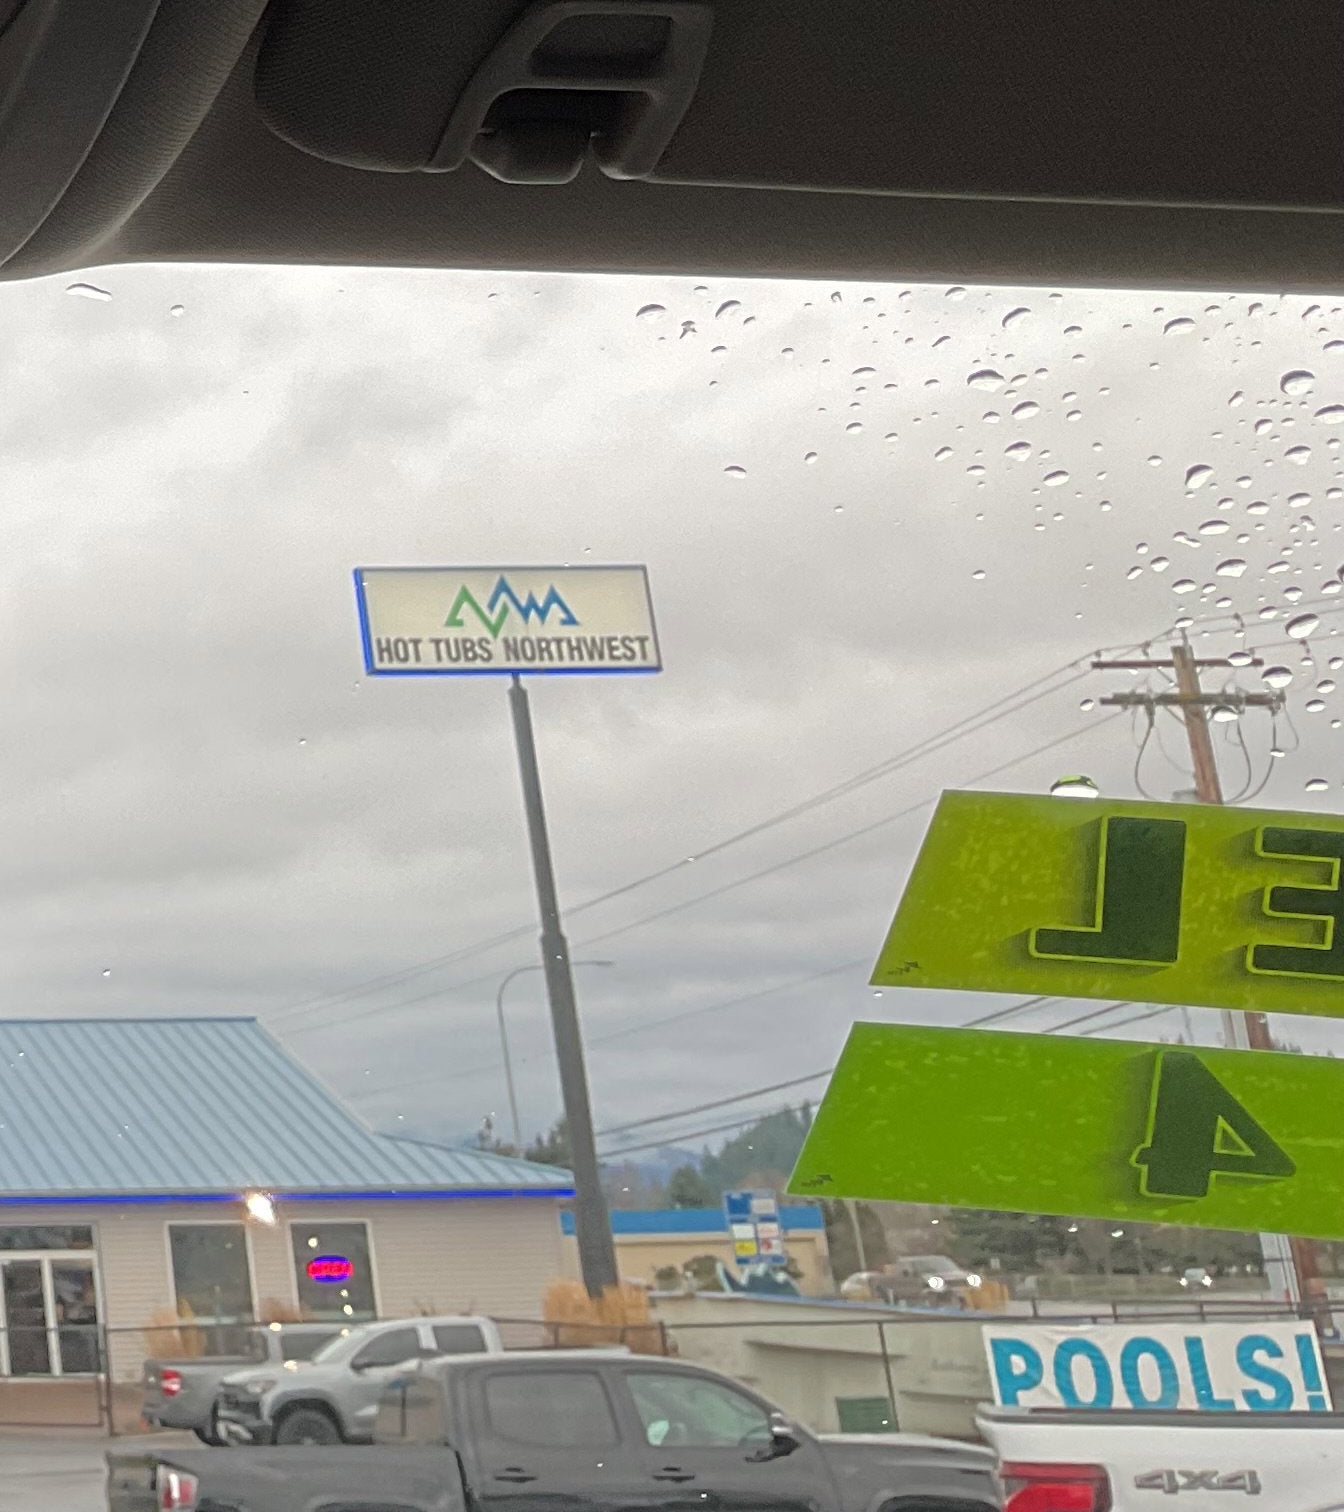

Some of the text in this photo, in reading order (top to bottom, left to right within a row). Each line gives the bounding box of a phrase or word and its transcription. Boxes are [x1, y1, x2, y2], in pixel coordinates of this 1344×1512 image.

[375, 635, 651, 664] HOT TUBS NORTHWEST
[989, 1333, 1327, 1412] POOLS!
